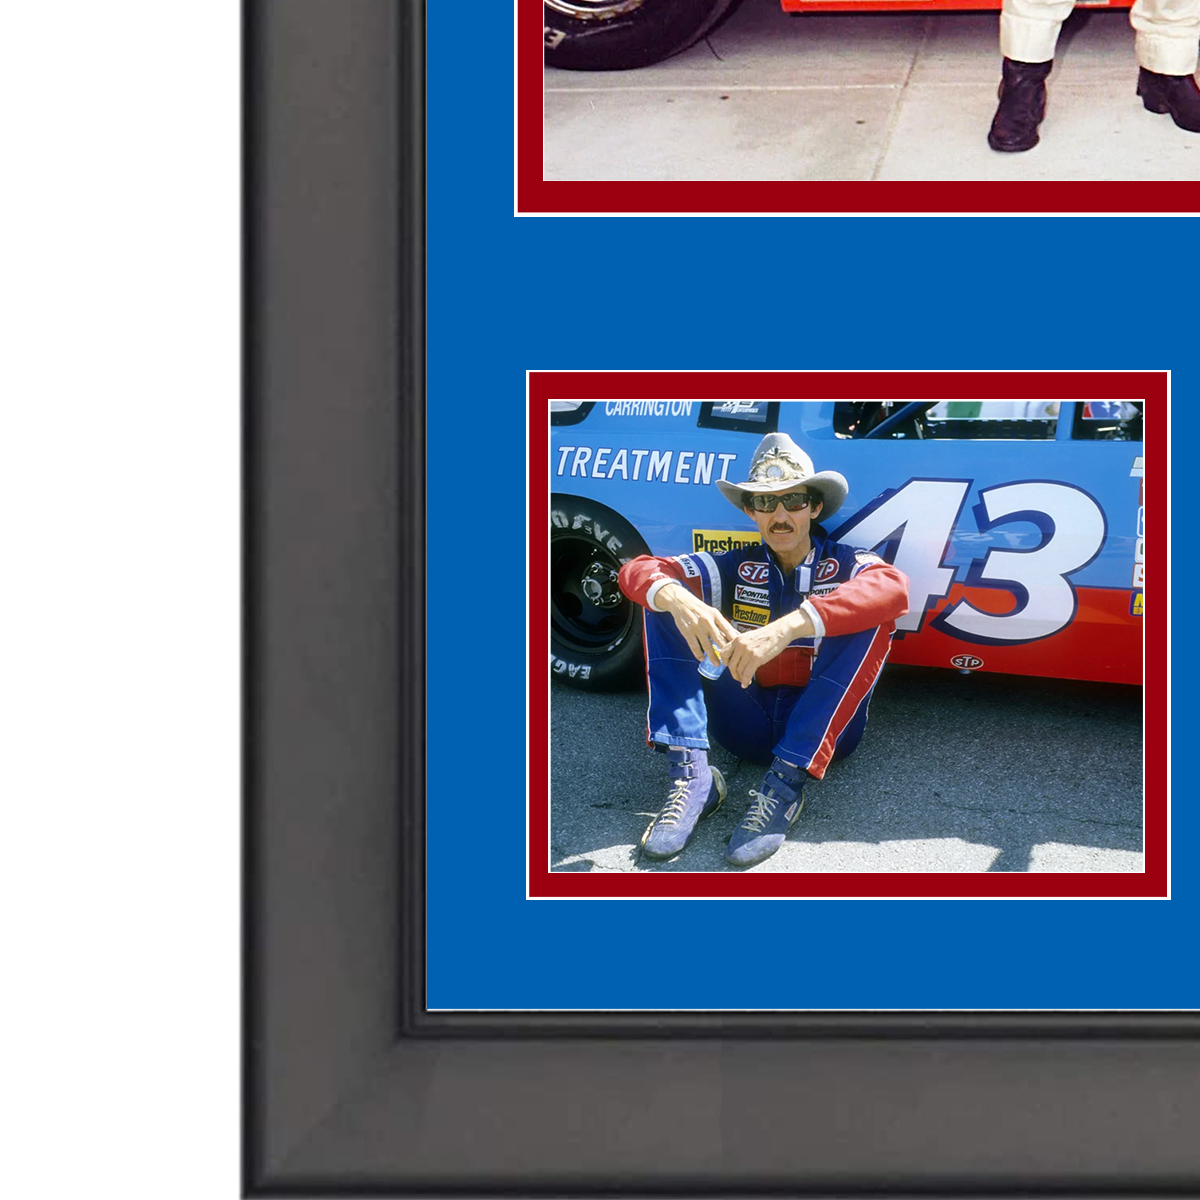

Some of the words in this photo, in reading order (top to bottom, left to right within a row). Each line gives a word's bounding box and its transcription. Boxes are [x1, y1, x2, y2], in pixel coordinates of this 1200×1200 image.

[605, 400, 693, 416] CARRINGTON
[556, 445, 737, 485] TREATMENT
[817, 561, 835, 579] TP
[828, 476, 1109, 647] 43
[741, 564, 769, 580] STP
[735, 605, 768, 623] Prestone
[551, 653, 592, 680] EAG
[955, 656, 979, 667] STP
